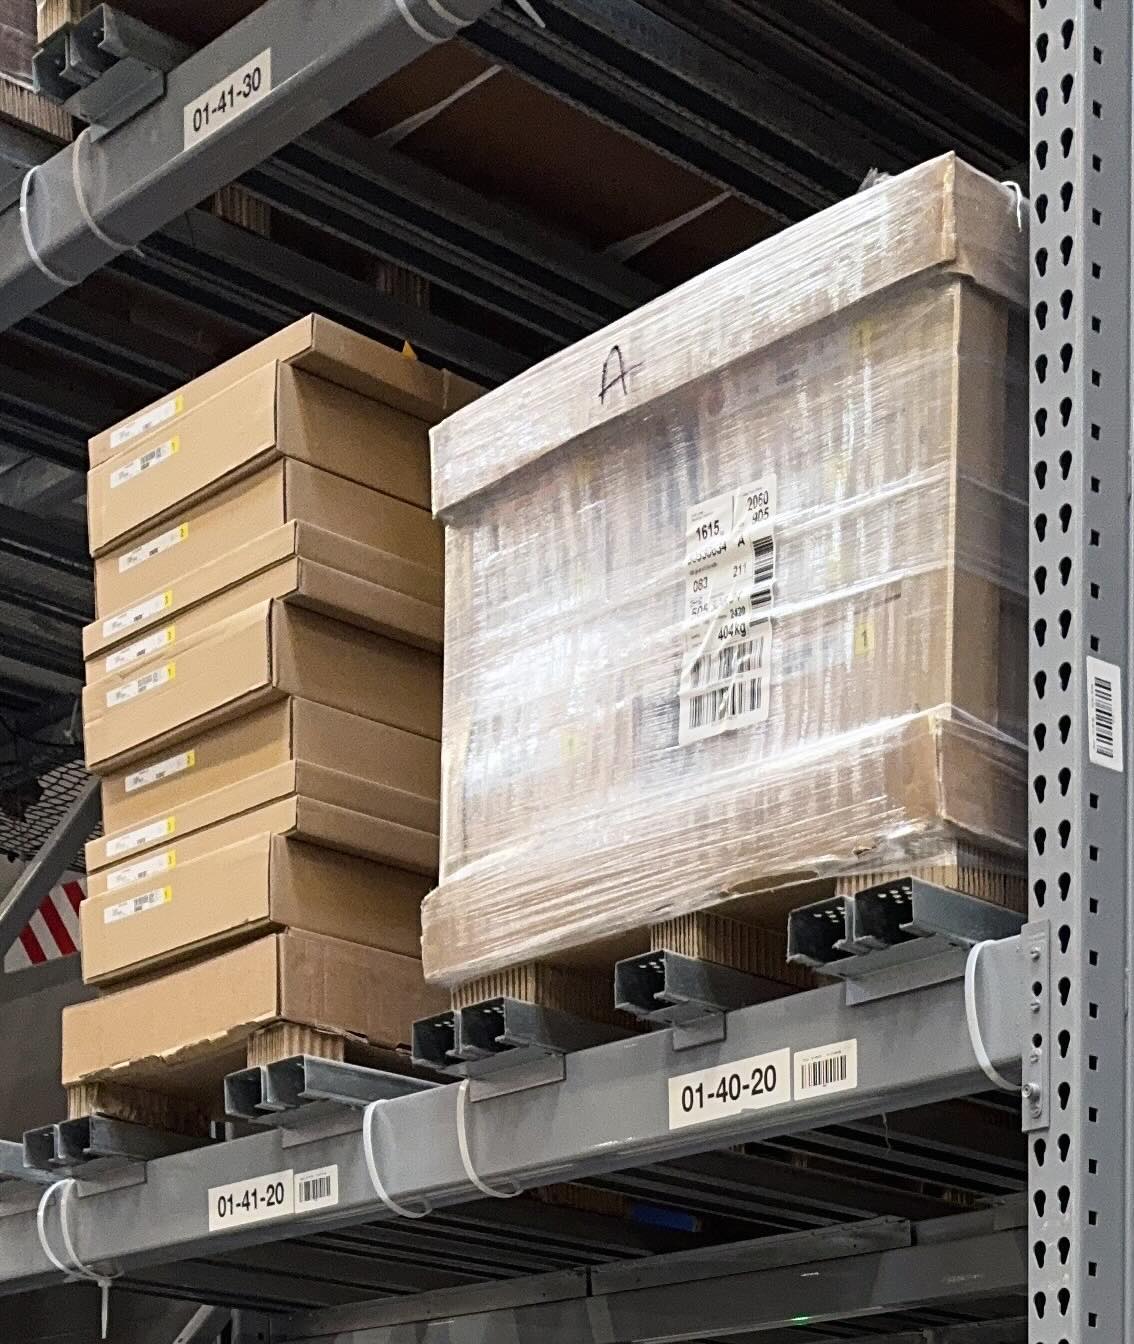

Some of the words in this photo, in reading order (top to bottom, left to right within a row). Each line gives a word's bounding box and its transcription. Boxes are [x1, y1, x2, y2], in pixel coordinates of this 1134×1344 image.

[193, 67, 261, 132] 01-41-30
[598, 344, 644, 405] A
[695, 520, 720, 541] 1615
[681, 1064, 777, 1112] 01-40-20
[217, 1181, 285, 1218] 01-41-20
